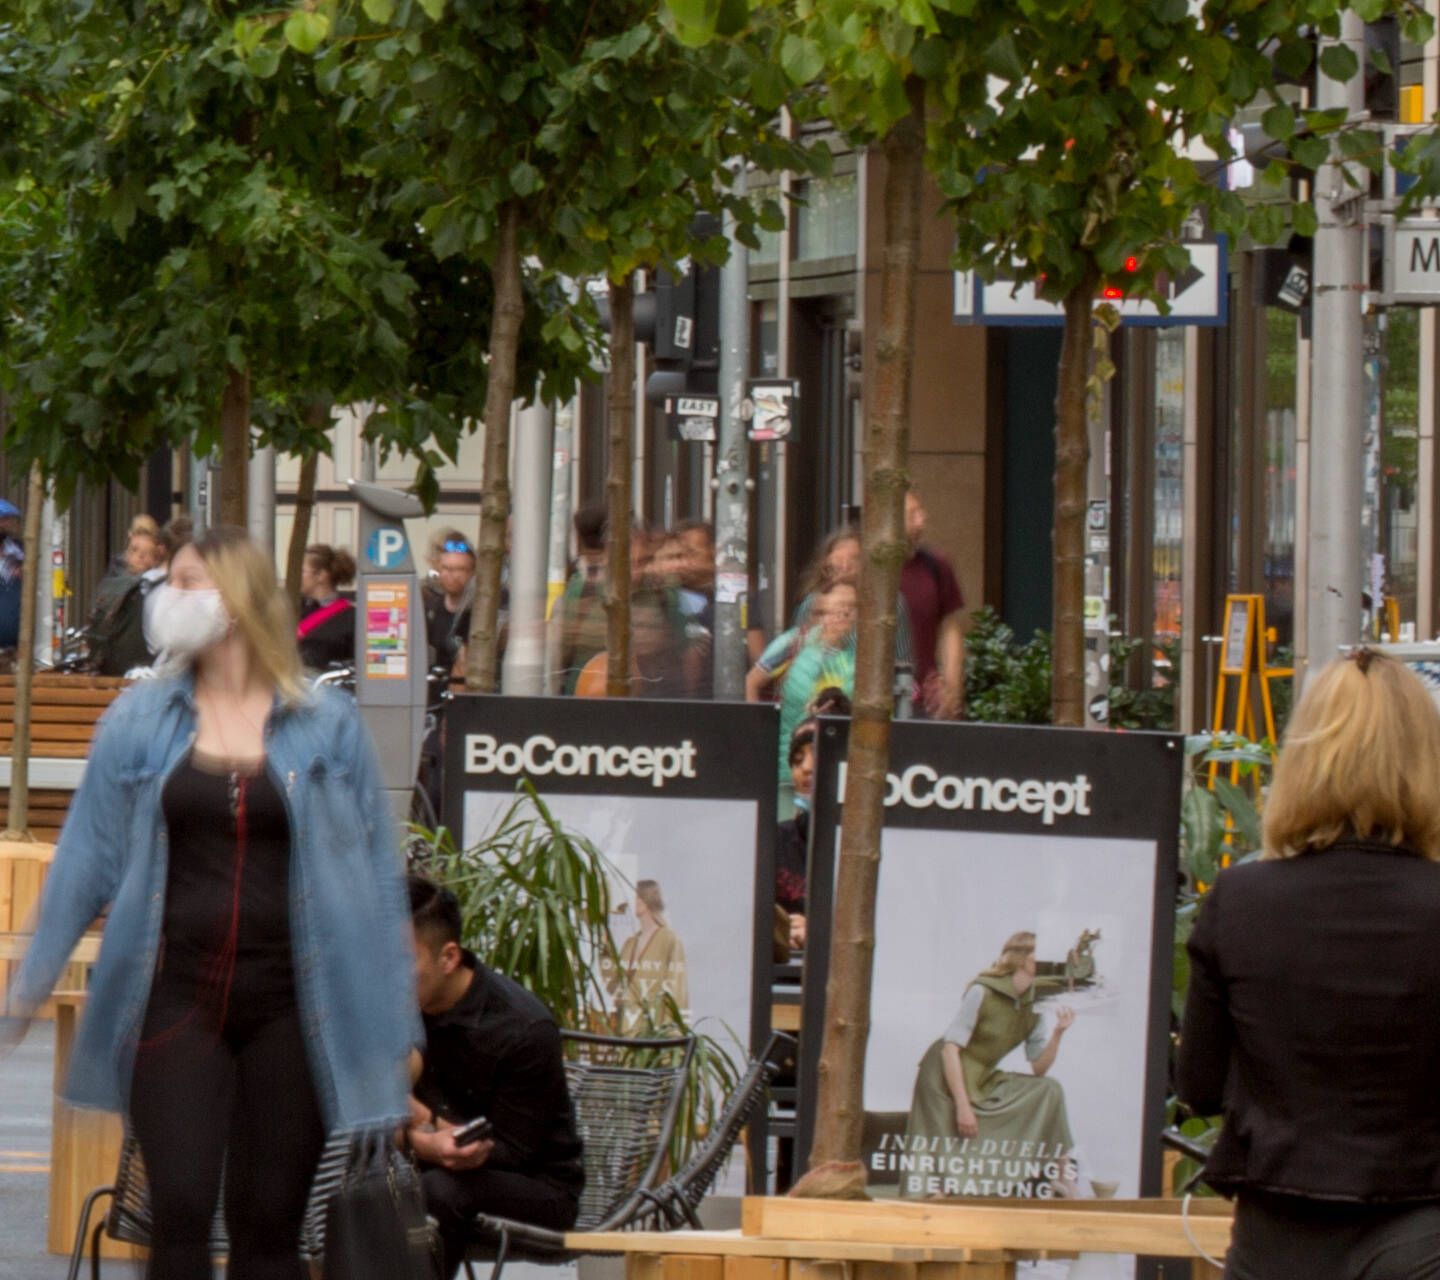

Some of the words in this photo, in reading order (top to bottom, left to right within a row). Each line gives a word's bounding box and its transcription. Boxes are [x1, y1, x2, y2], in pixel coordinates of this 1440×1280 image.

[681, 400, 714, 412] EAST
[378, 529, 404, 567] P
[464, 734, 697, 787] BoConcept
[837, 761, 1091, 824] oConcept
[871, 1152, 1078, 1181] EINRICHTUNGS
[907, 1175, 1053, 1200] BERATUNG
